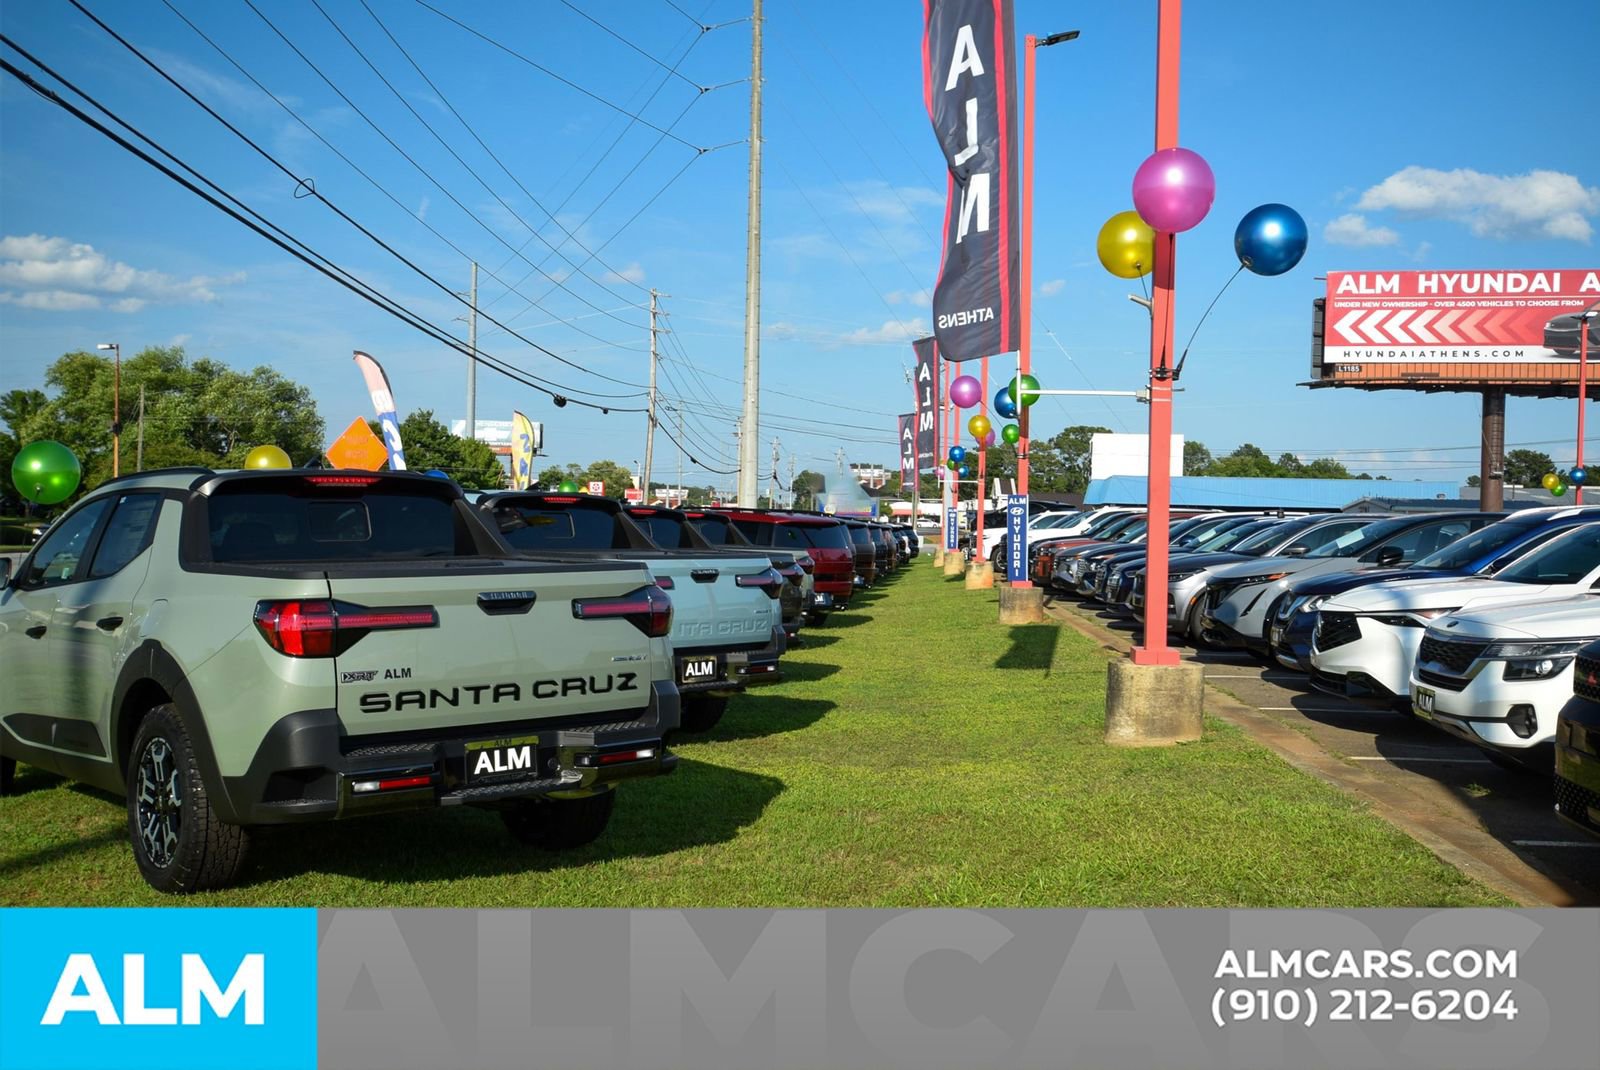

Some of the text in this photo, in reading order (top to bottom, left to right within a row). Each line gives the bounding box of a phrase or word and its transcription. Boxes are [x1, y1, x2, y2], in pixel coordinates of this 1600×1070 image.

[1336, 273, 1400, 295] ALM
[1417, 272, 1561, 294] HYUNDAI
[1343, 350, 1525, 358] HYUNDAIATHENS.COM
[1008, 497, 1027, 505] ALM
[1013, 516, 1021, 577] HYUNDAI
[384, 667, 412, 680] ALM
[685, 661, 713, 677] ALM
[359, 672, 638, 714] SANTA CRUZ
[473, 745, 532, 775] ALM
